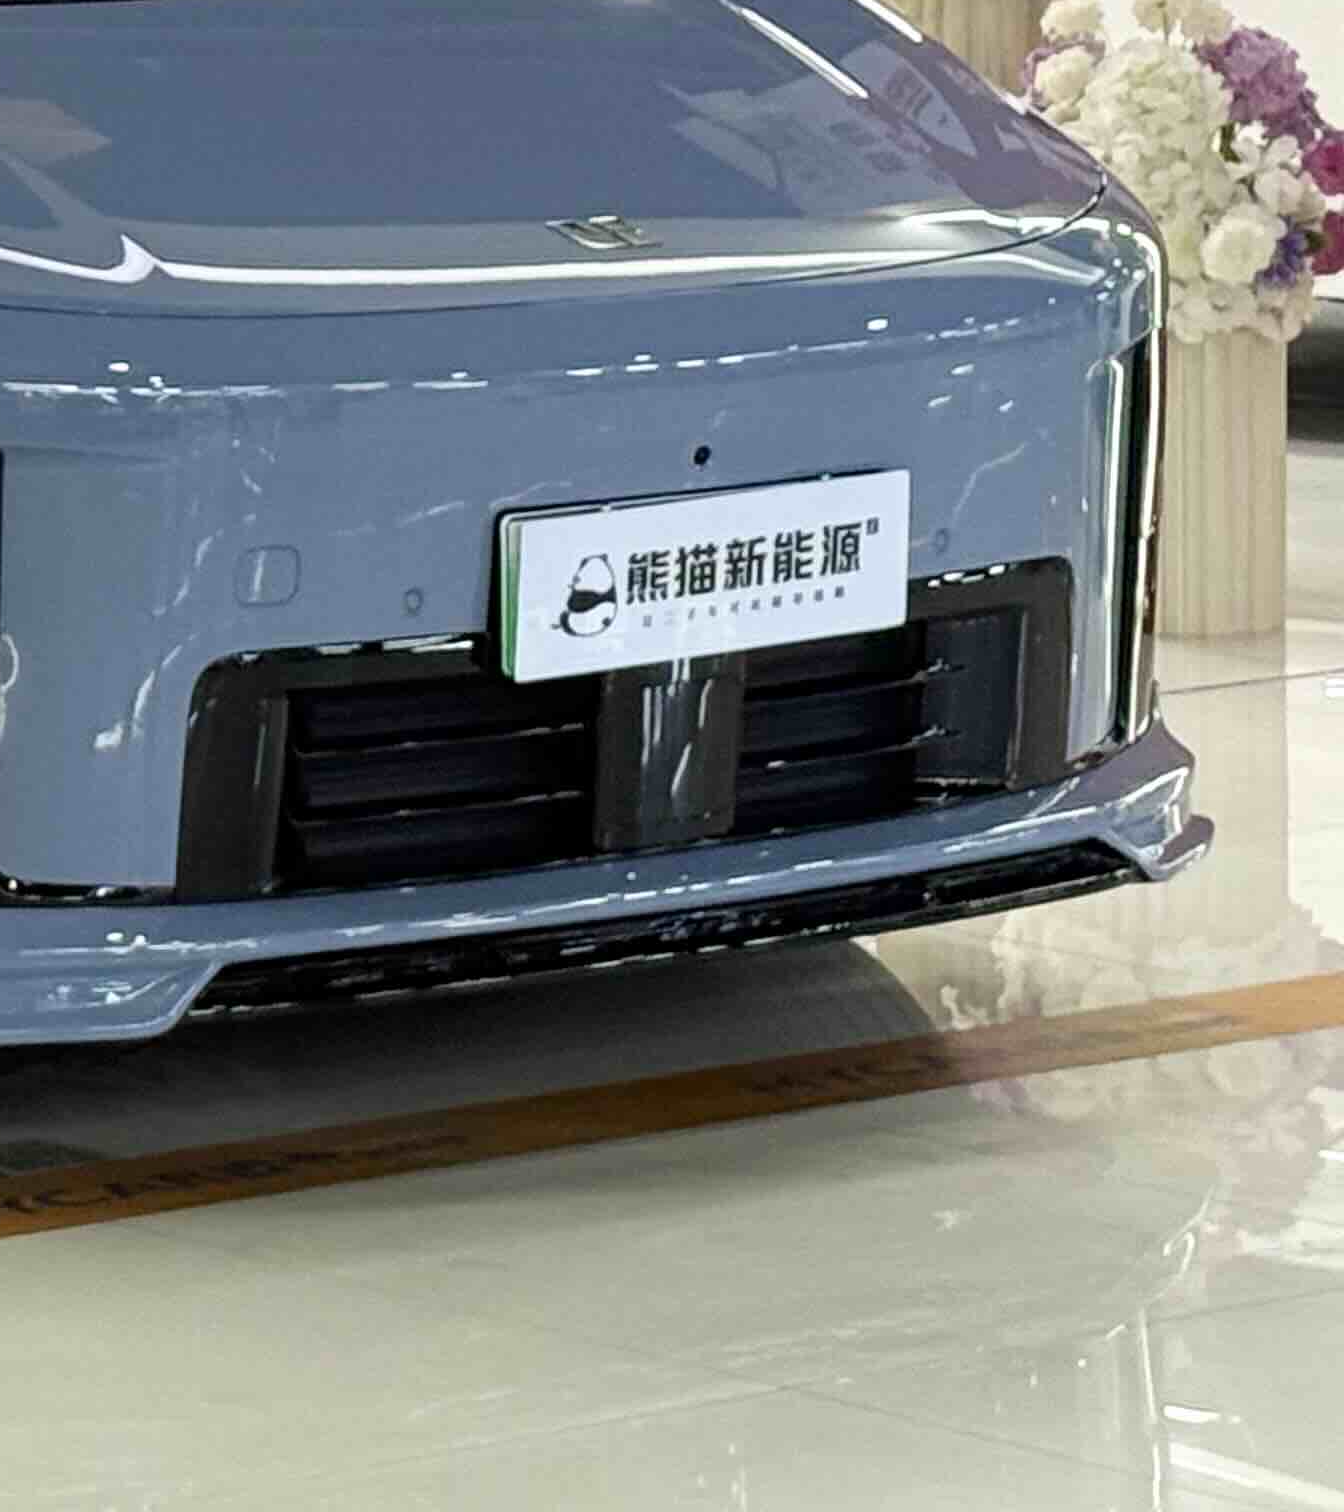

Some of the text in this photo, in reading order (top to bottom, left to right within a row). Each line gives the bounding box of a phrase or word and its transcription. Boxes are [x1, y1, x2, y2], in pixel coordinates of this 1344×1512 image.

[625, 521, 863, 606] 熊猫新能源
